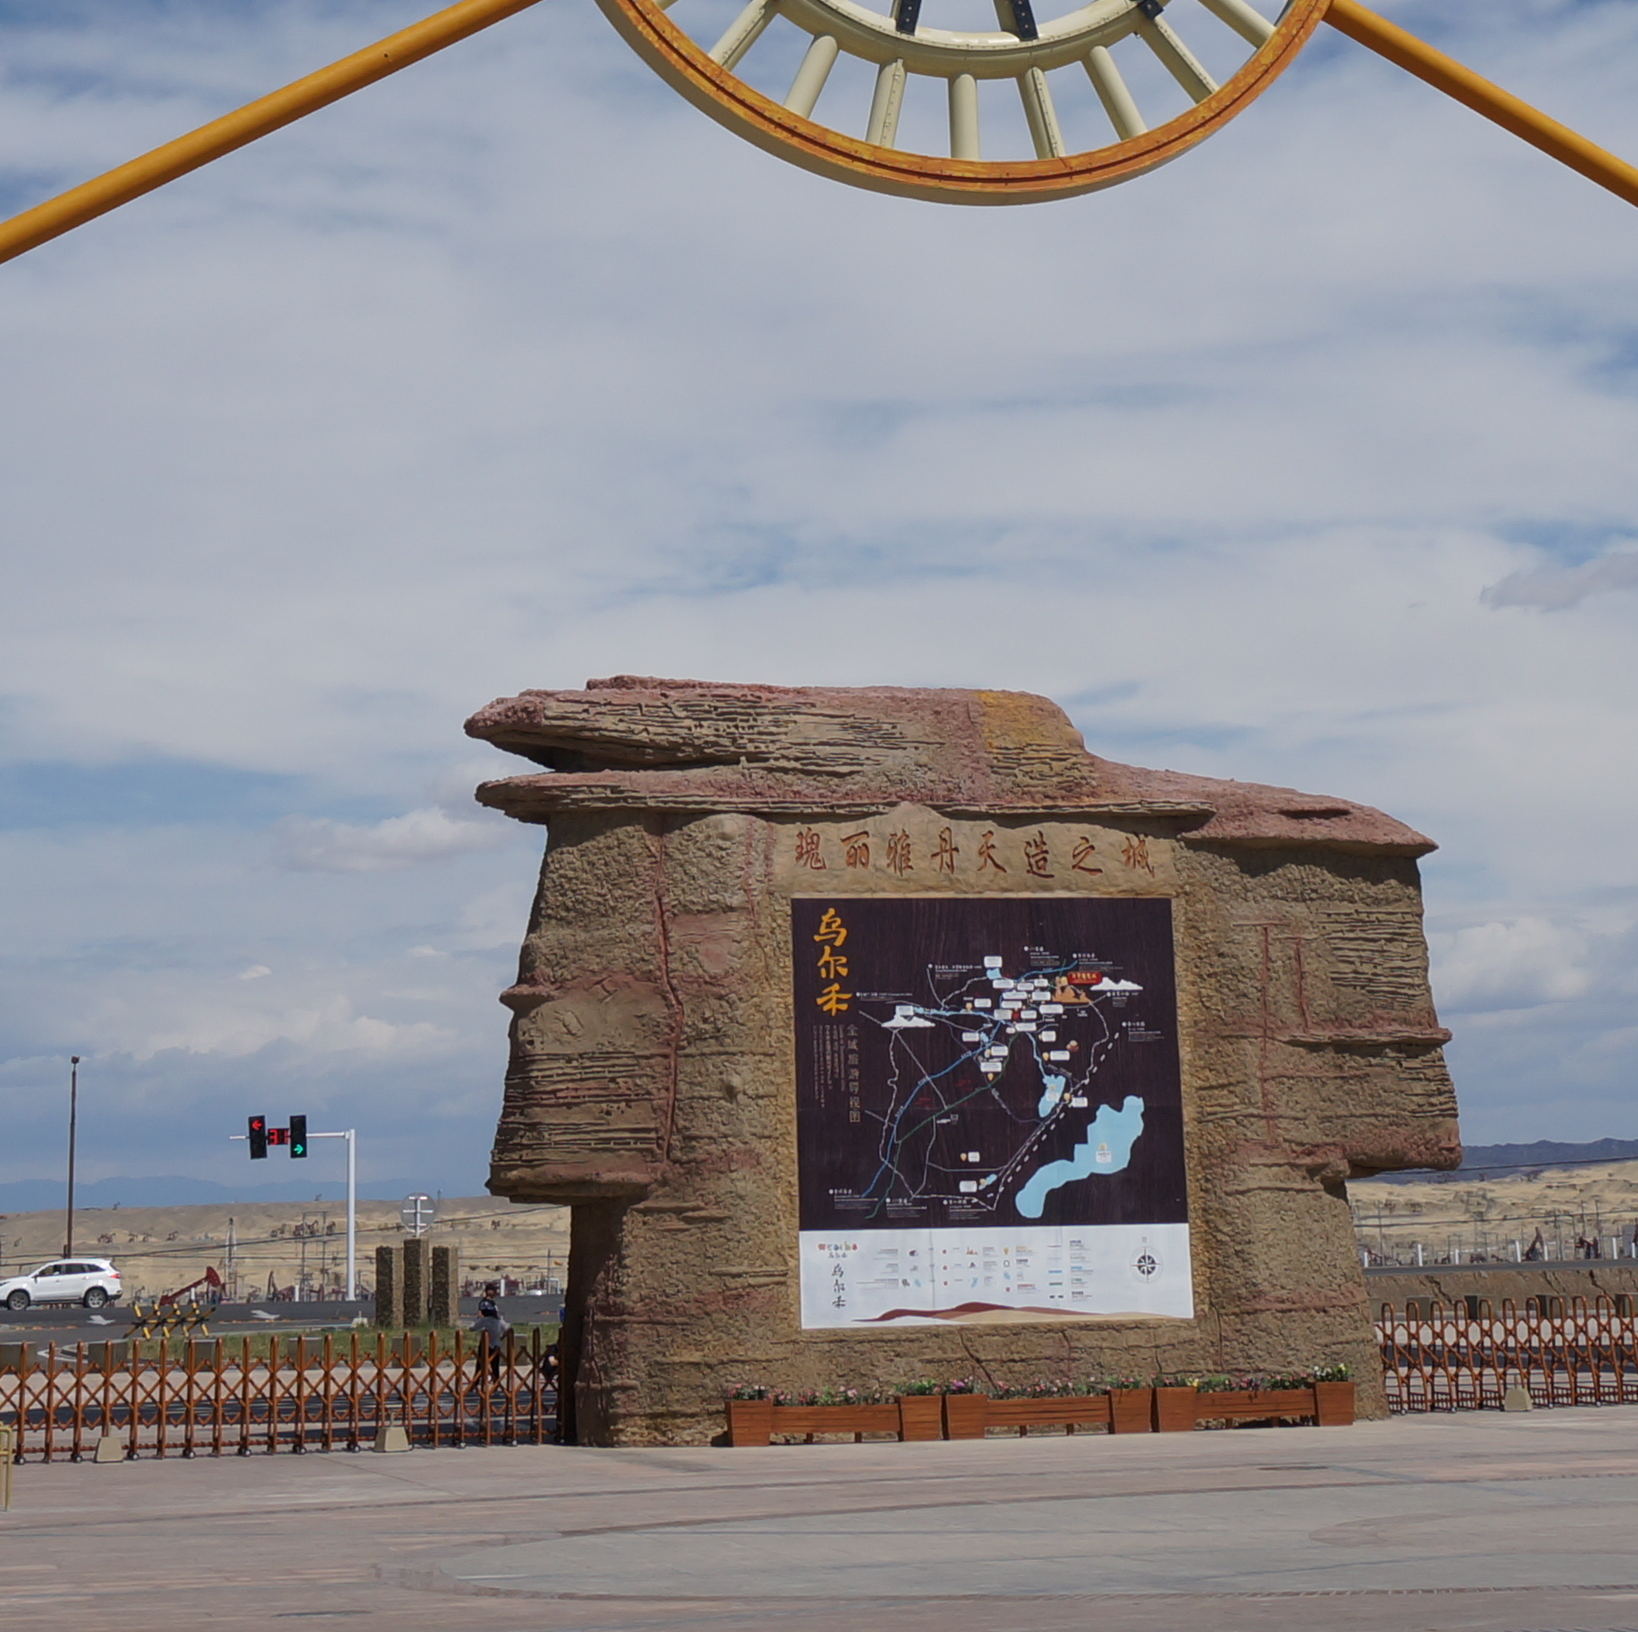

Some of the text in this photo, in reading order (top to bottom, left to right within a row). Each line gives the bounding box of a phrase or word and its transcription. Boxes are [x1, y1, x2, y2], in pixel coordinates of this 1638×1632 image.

[795, 826, 1157, 879] 瑰丽雅丹天造之城
[812, 907, 853, 1017] 乌尔禾
